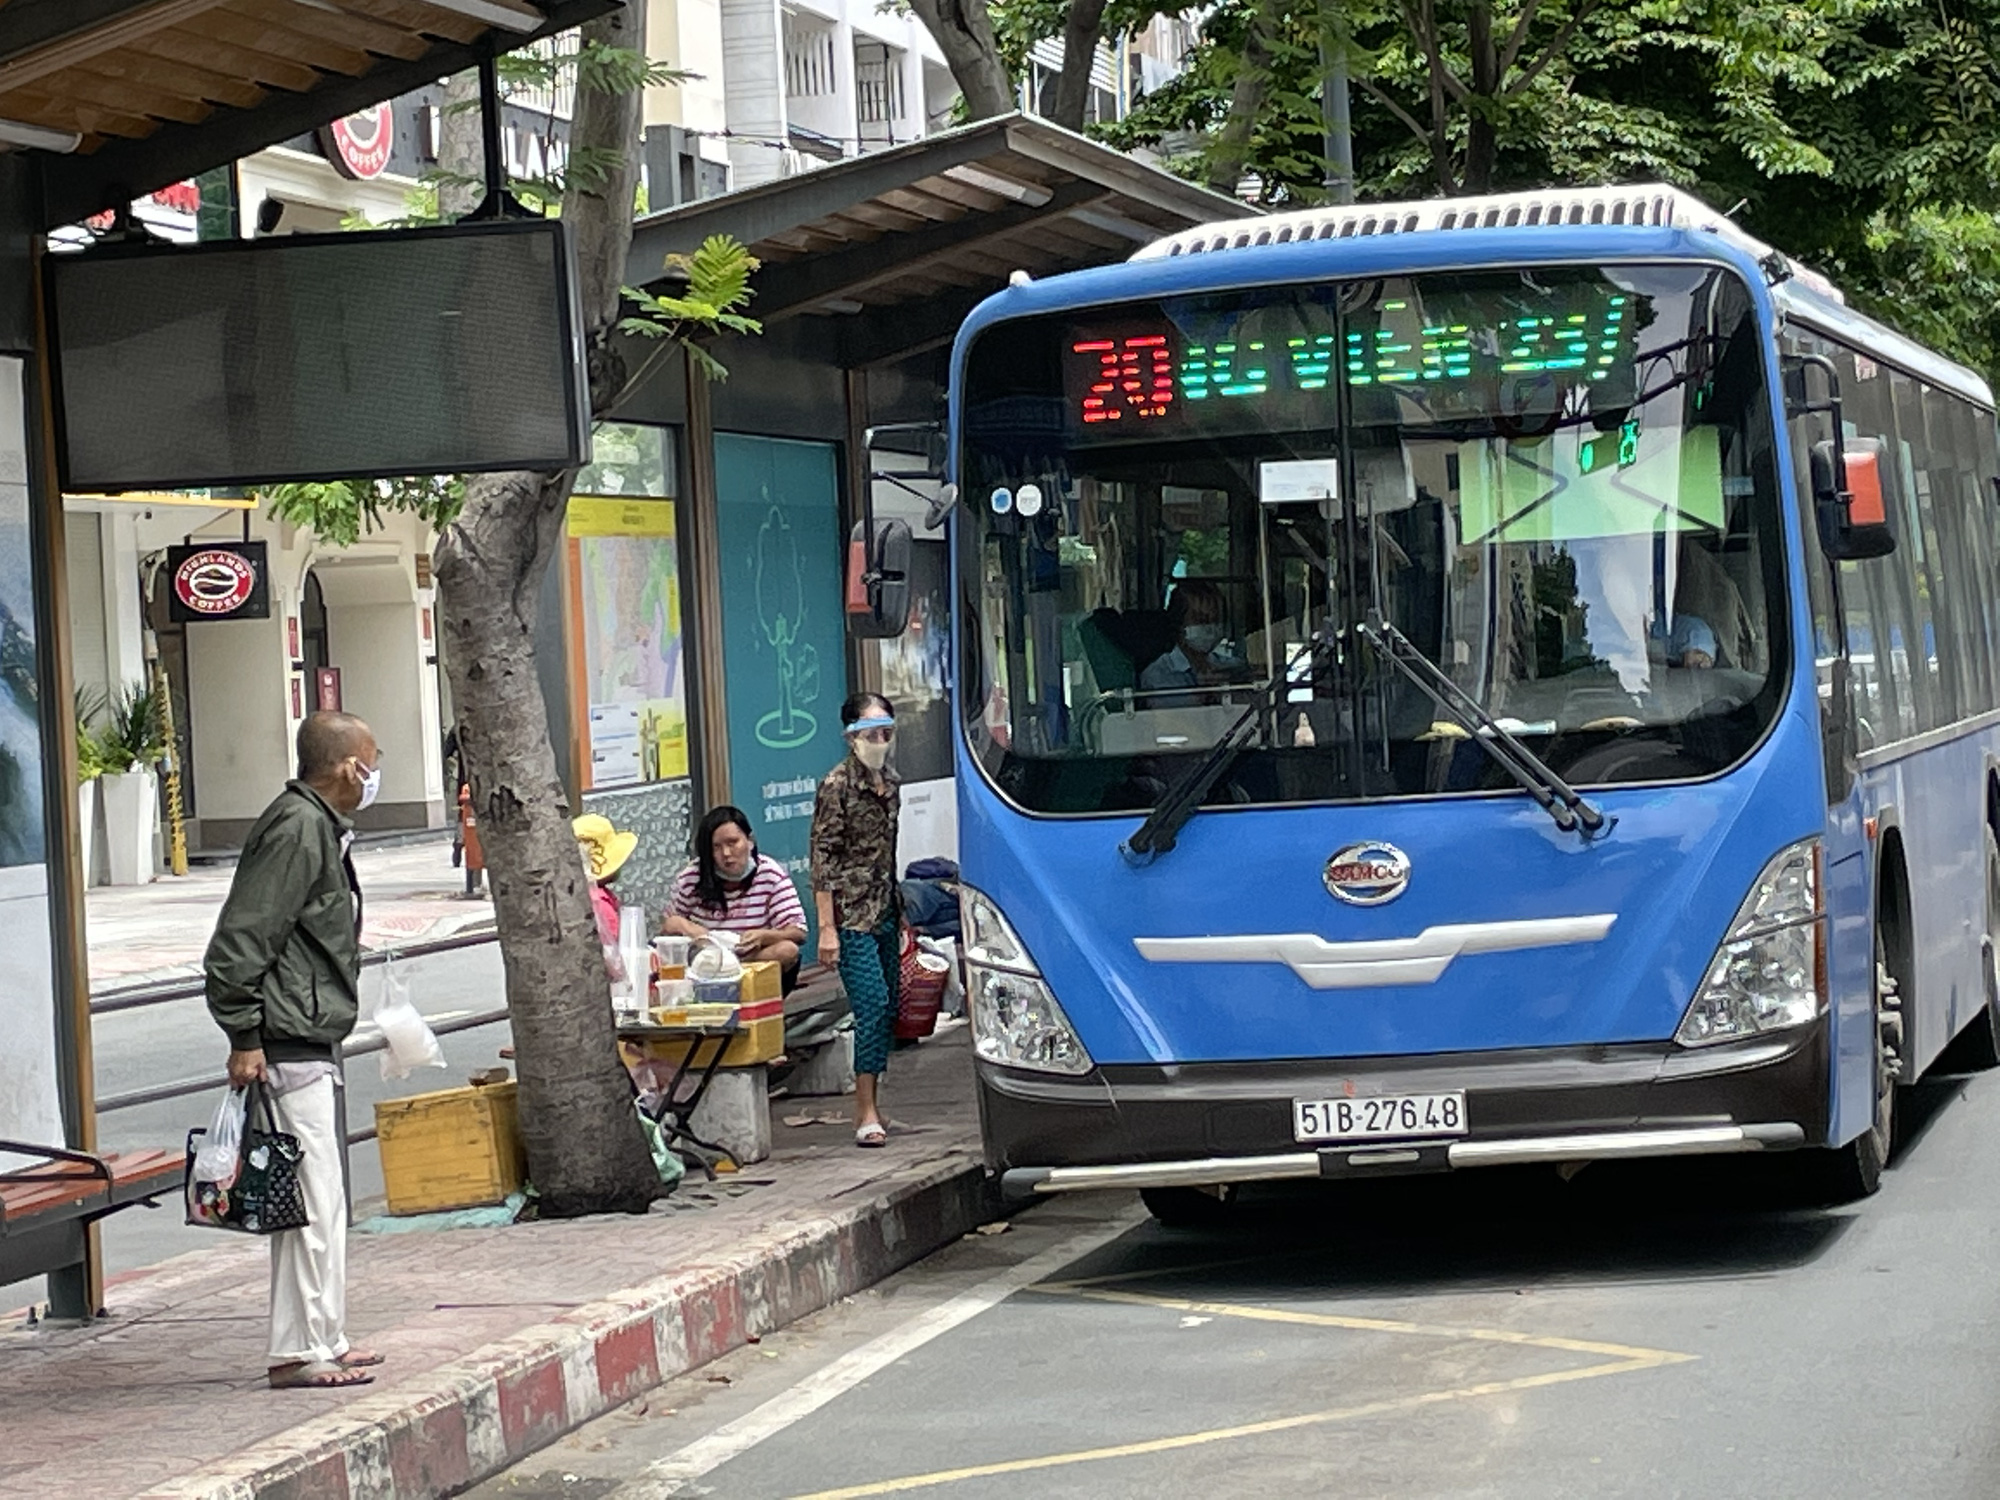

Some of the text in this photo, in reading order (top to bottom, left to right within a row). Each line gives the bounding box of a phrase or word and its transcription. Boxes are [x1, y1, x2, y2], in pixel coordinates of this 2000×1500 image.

[181, 553, 249, 581] HIGHLANDS
[188, 594, 241, 610] COFFEE
[1329, 862, 1404, 882] SAMCO
